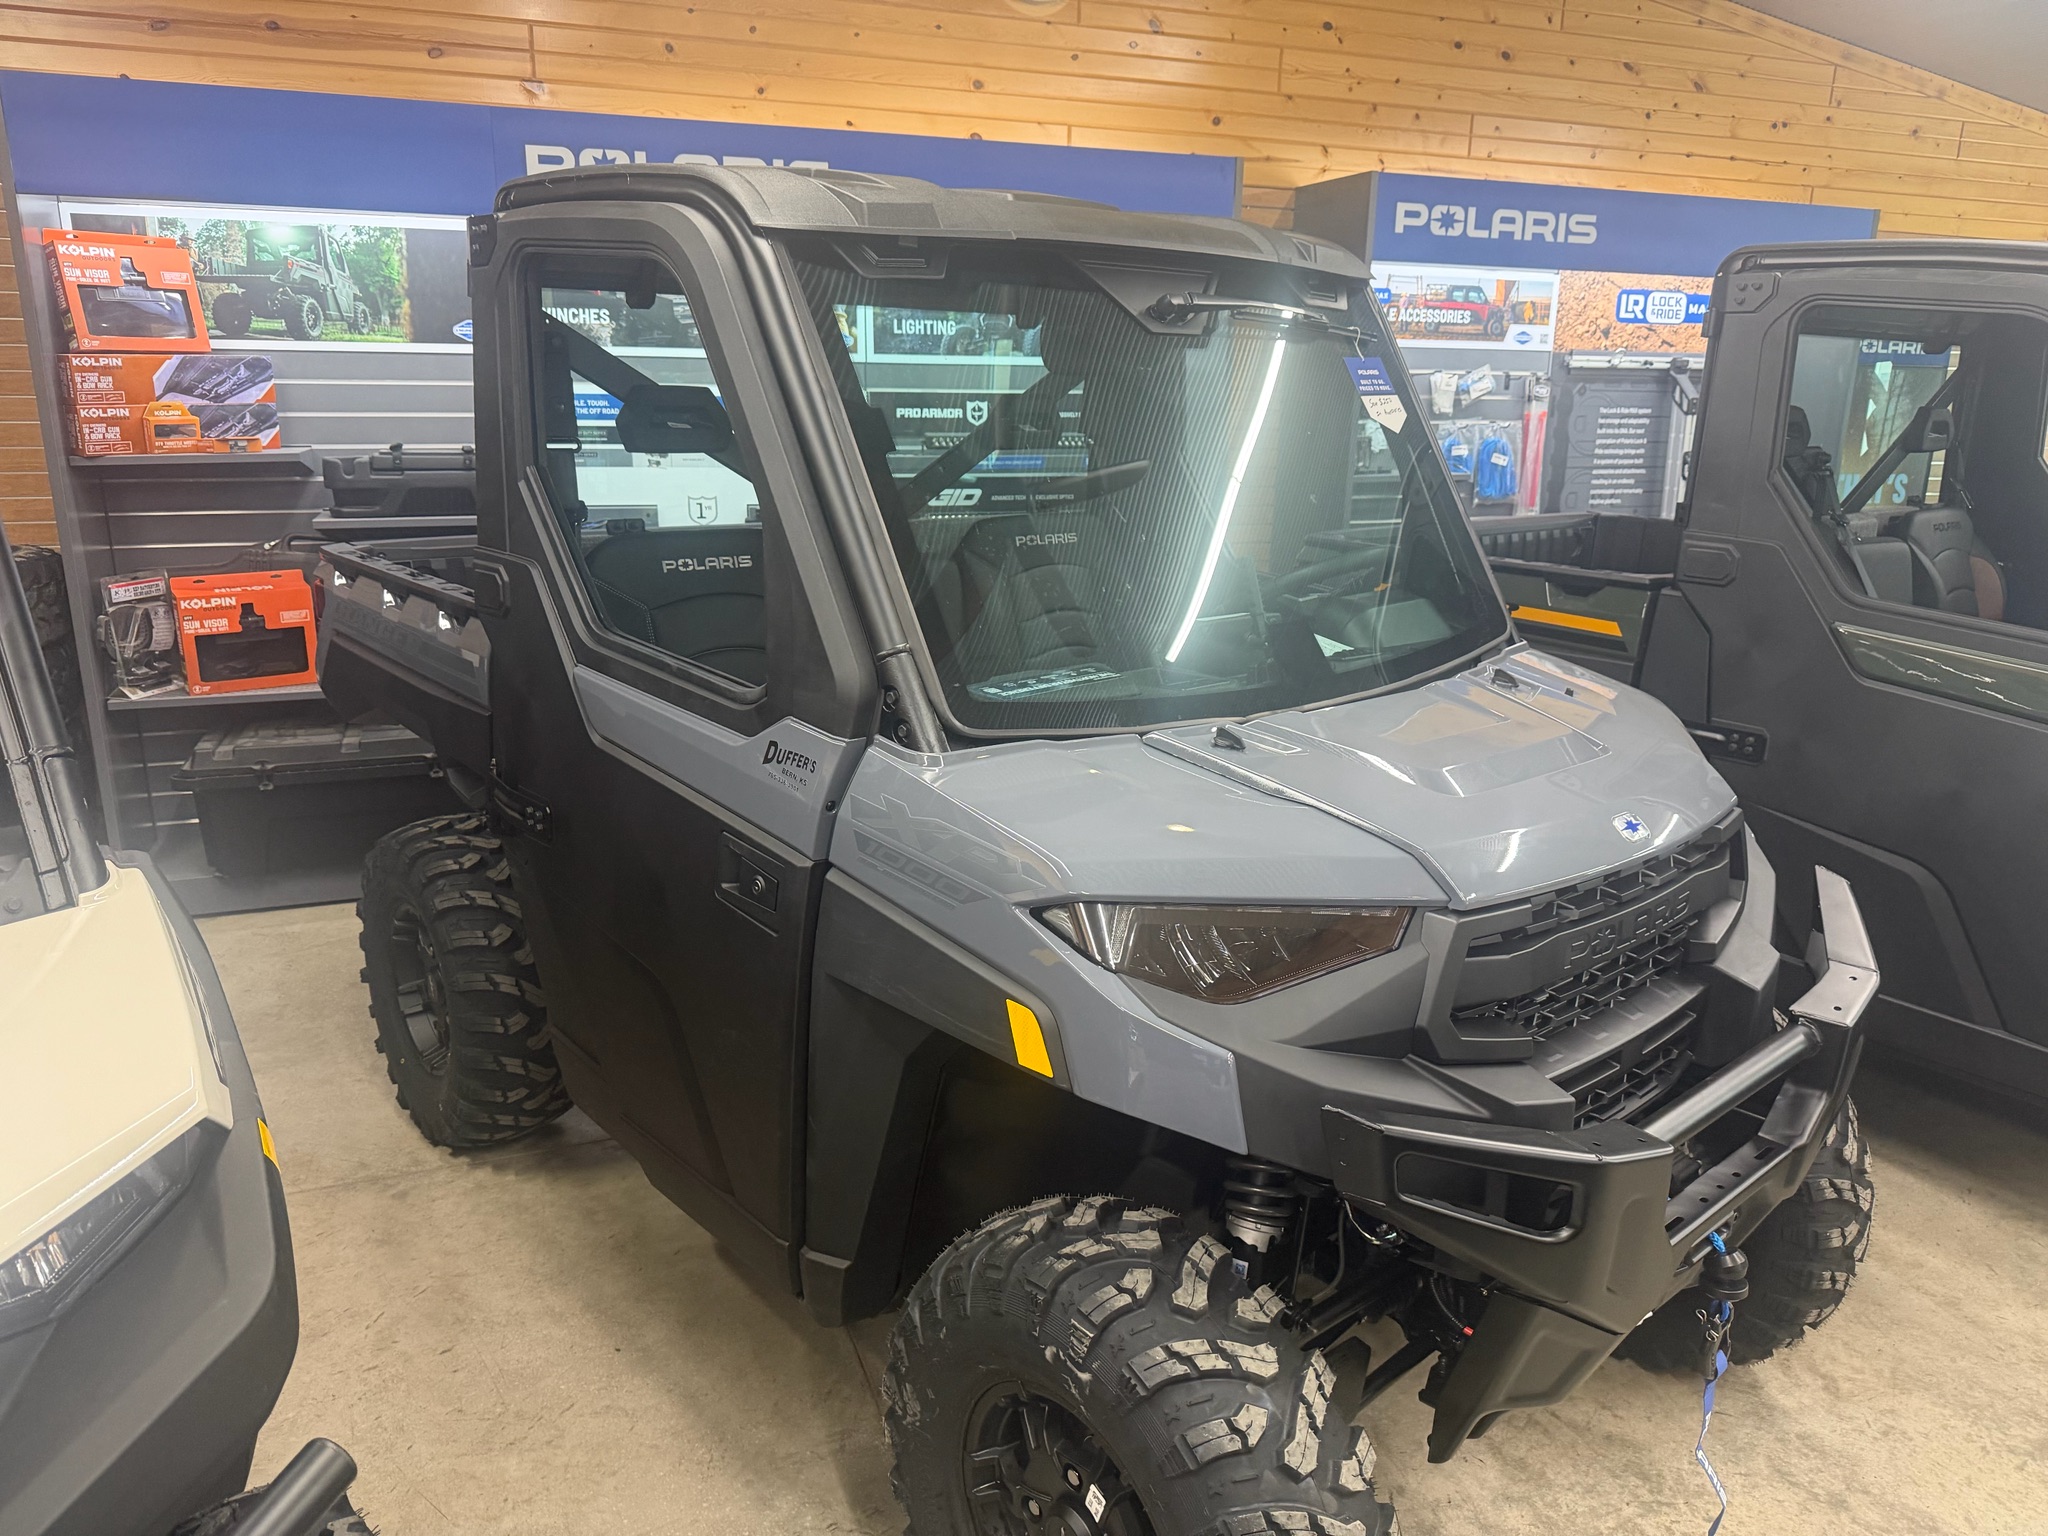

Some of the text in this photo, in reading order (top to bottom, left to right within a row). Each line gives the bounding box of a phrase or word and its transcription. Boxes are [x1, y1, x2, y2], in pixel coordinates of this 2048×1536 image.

[1395, 202, 1598, 245] POLARIS
[58, 244, 115, 257] KOLPIN
[64, 268, 110, 279] SUN VISOR
[1652, 296, 1682, 308] LOCK
[1398, 308, 1472, 324] ACCESSORIES
[893, 318, 956, 336] LIGHTING
[1860, 338, 1926, 355] OLARI
[72, 356, 123, 367] KOLPIN
[80, 407, 130, 418] KOLPIN
[577, 407, 620, 415] THE OFF ROAD
[696, 502, 707, 519] 1
[1015, 532, 1078, 547] POLARIS
[661, 555, 753, 573] POLARIS
[180, 596, 237, 609] KOLPIN
[183, 618, 229, 630] SUN VISOR
[762, 740, 817, 774] DUFFER'S
[1564, 891, 1691, 970] POLARIS
